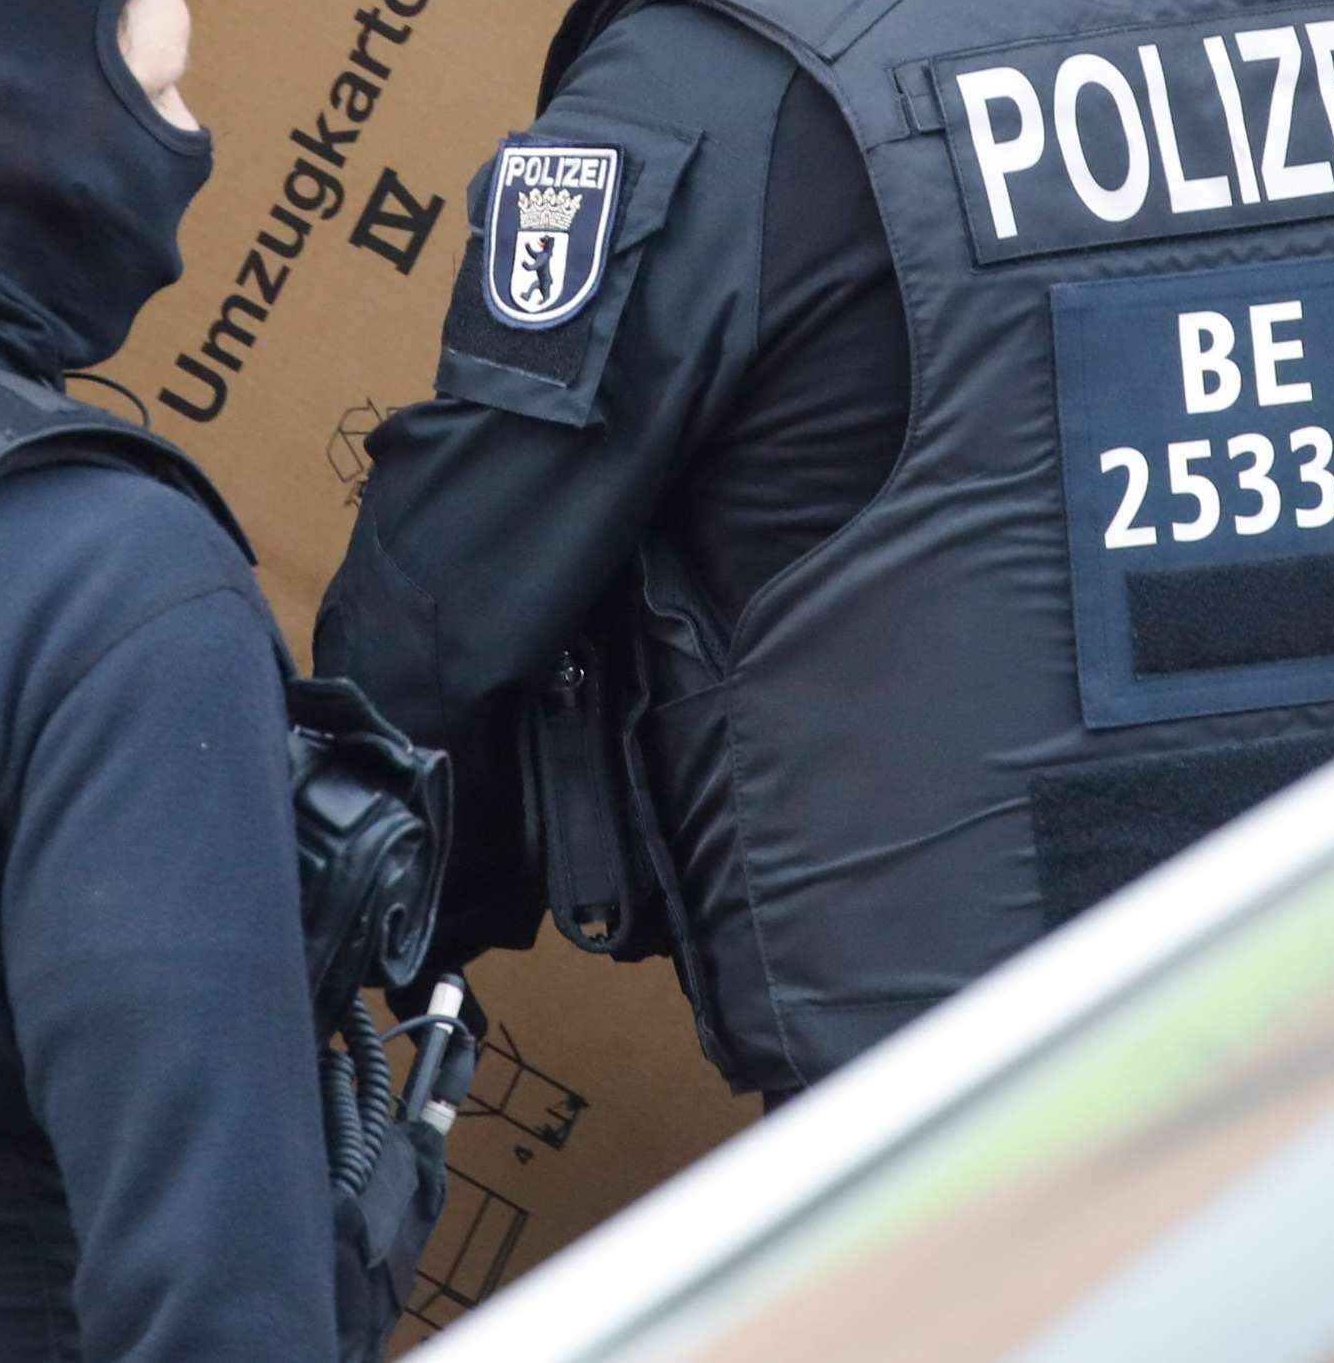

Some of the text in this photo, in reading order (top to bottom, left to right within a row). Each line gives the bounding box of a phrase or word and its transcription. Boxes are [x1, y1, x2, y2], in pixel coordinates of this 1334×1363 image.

[347, 167, 445, 275] IV
[504, 155, 608, 190] POLIZEI
[1177, 300, 1313, 415] BE
